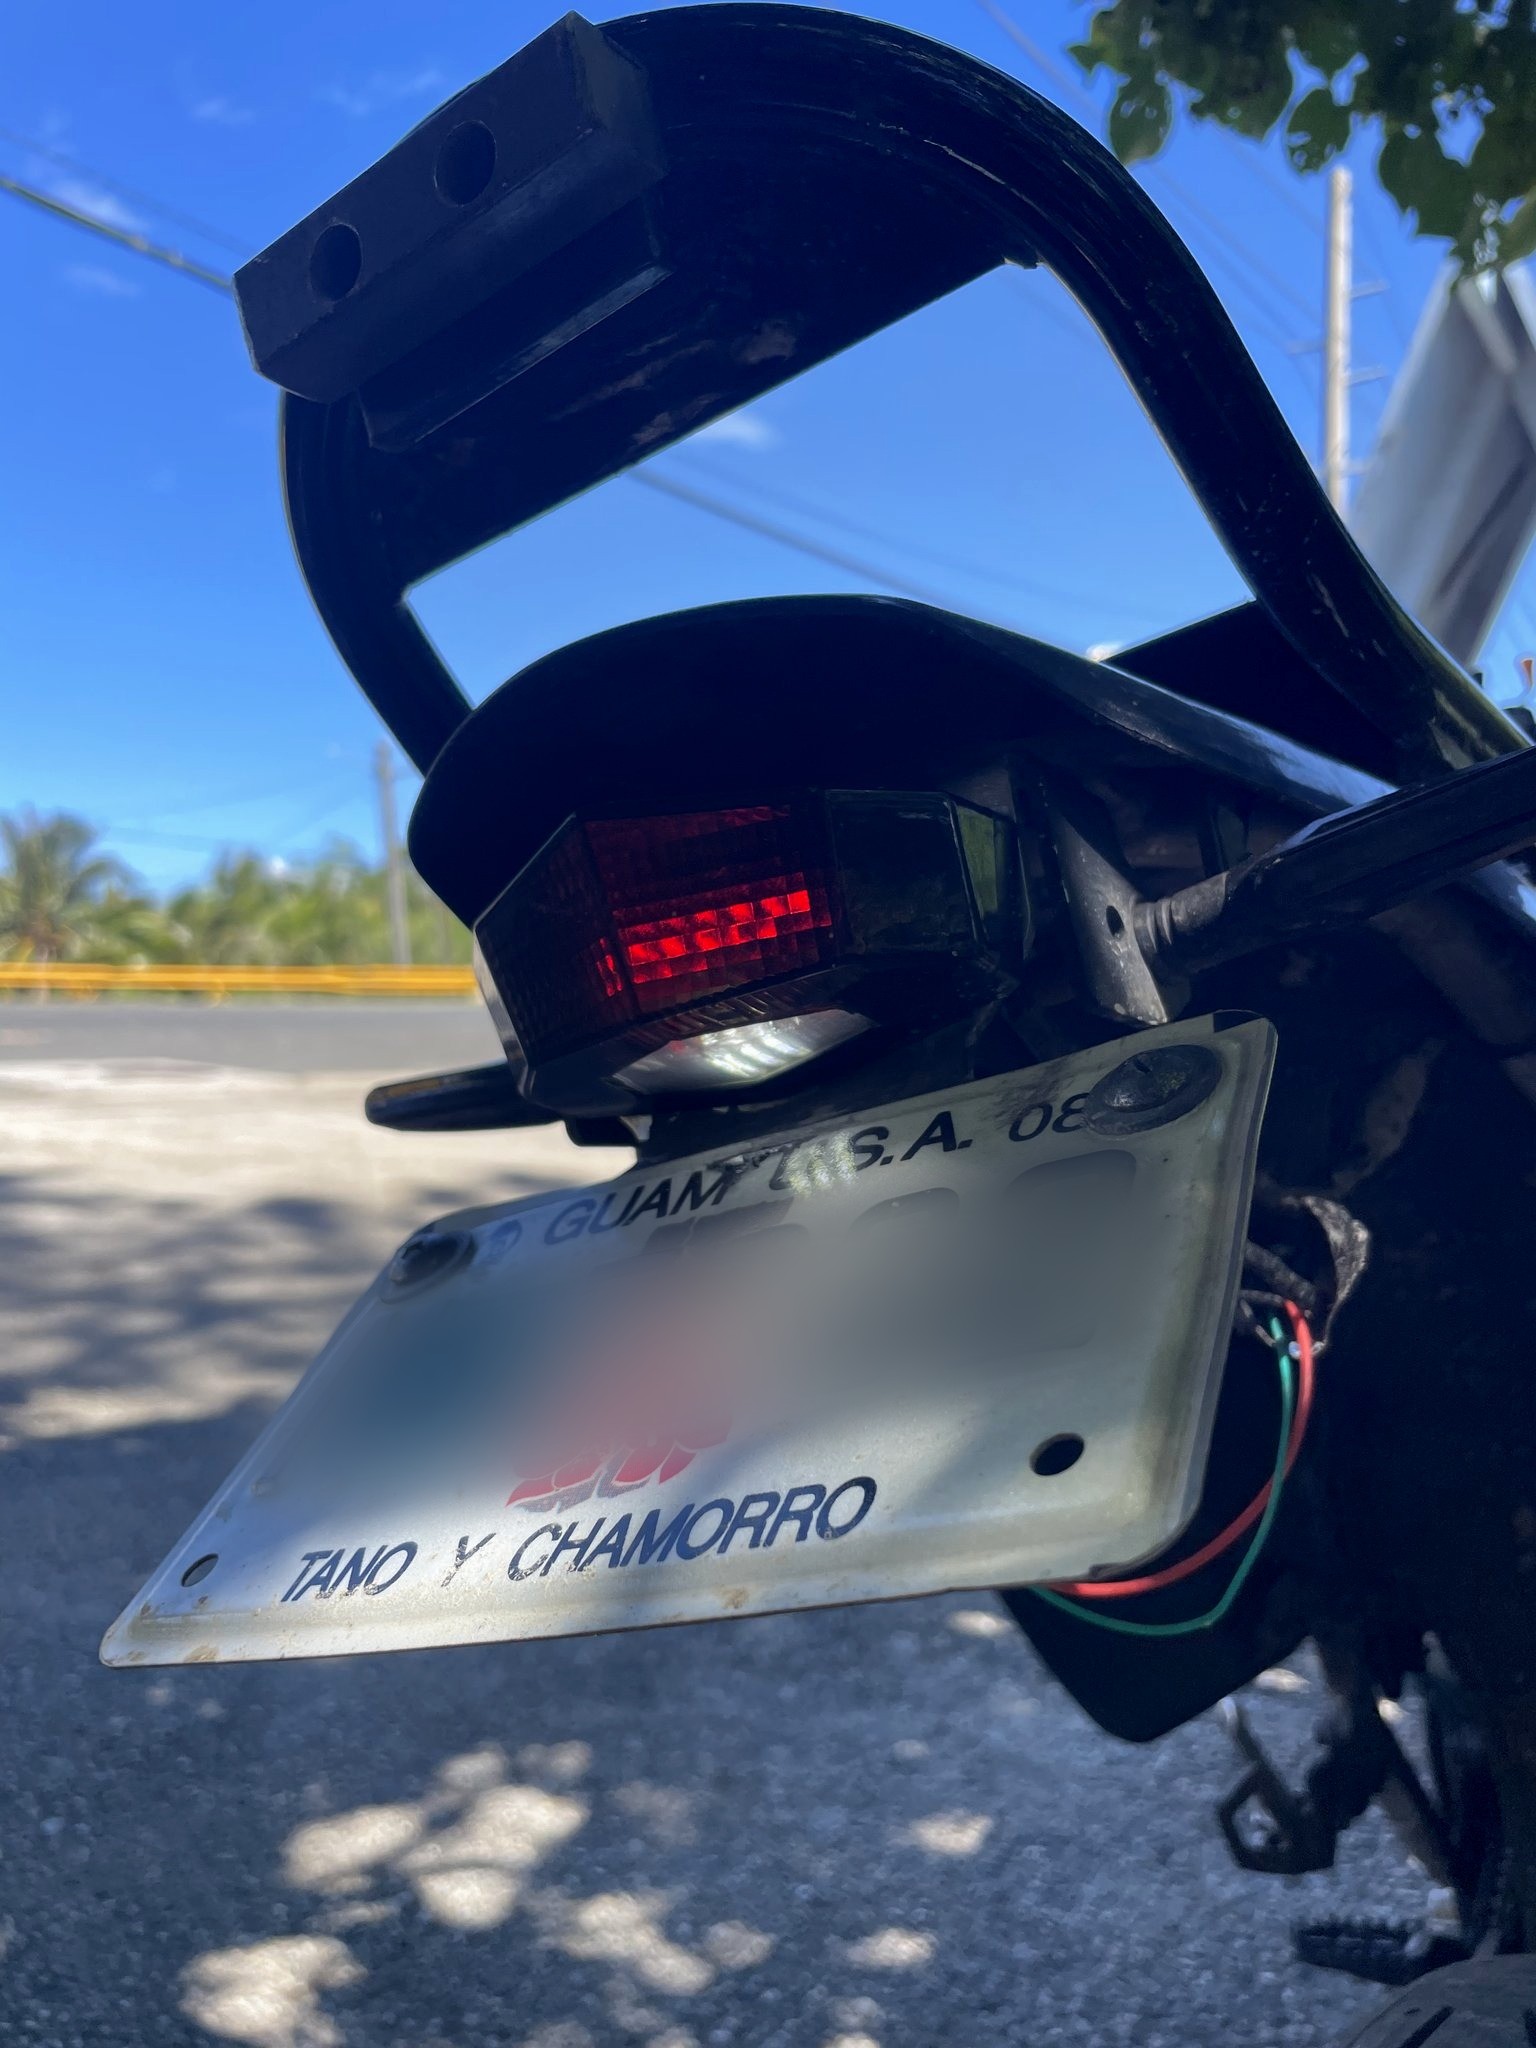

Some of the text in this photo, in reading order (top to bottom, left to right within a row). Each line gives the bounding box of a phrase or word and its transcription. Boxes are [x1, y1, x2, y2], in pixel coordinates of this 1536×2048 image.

[544, 1166, 734, 1246] GUAM
[769, 1111, 973, 1191] US.A.
[280, 1476, 877, 1602] TANO Y CHAMORRO
